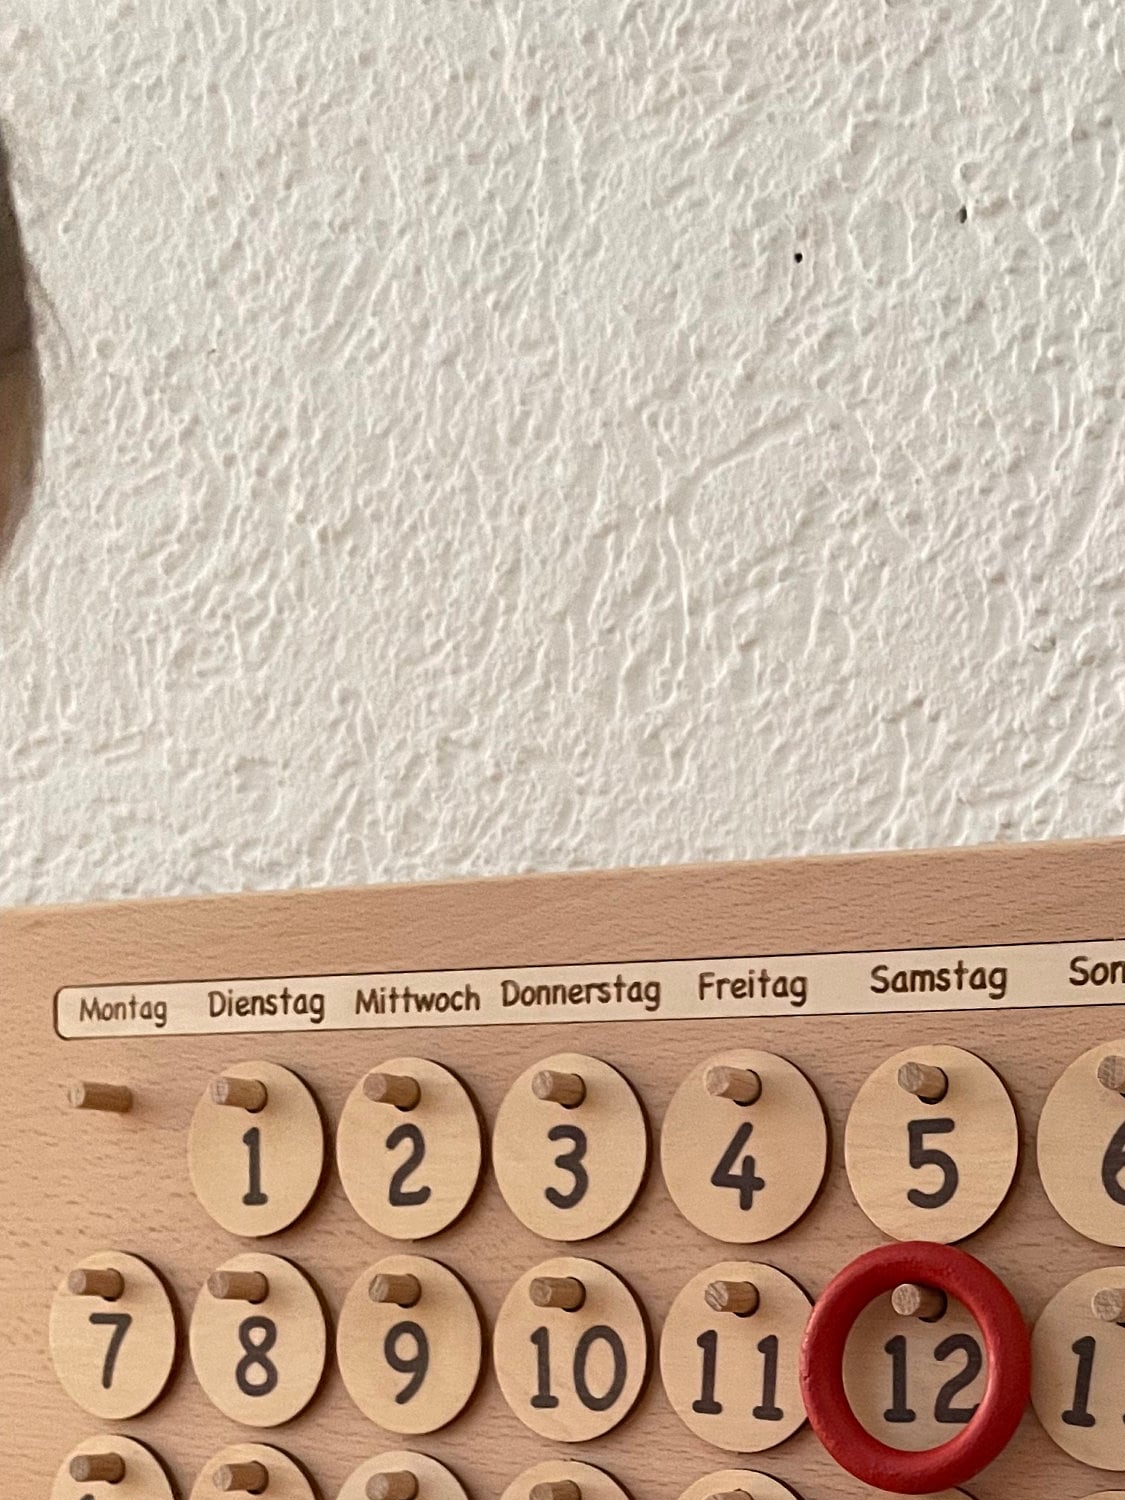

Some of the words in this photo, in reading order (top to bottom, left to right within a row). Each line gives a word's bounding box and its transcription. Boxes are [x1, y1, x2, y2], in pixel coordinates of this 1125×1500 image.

[79, 997, 168, 1028] Montag
[207, 989, 326, 1022] Dienstag
[354, 986, 481, 1015] Mittwoch
[500, 974, 662, 1011] Donnerstag
[698, 968, 808, 1007] Freitag
[870, 961, 1009, 999] Samstag
[241, 1126, 269, 1206] 1
[384, 1123, 431, 1207] 2
[544, 1124, 590, 1210] 3
[709, 1121, 765, 1211] 4
[906, 1117, 960, 1210] 5
[89, 1312, 133, 1389] 7
[235, 1315, 279, 1398] 8
[383, 1321, 430, 1404] 9
[529, 1323, 627, 1412] 10
[691, 1329, 784, 1421] 11
[883, 1333, 985, 1424] 12
